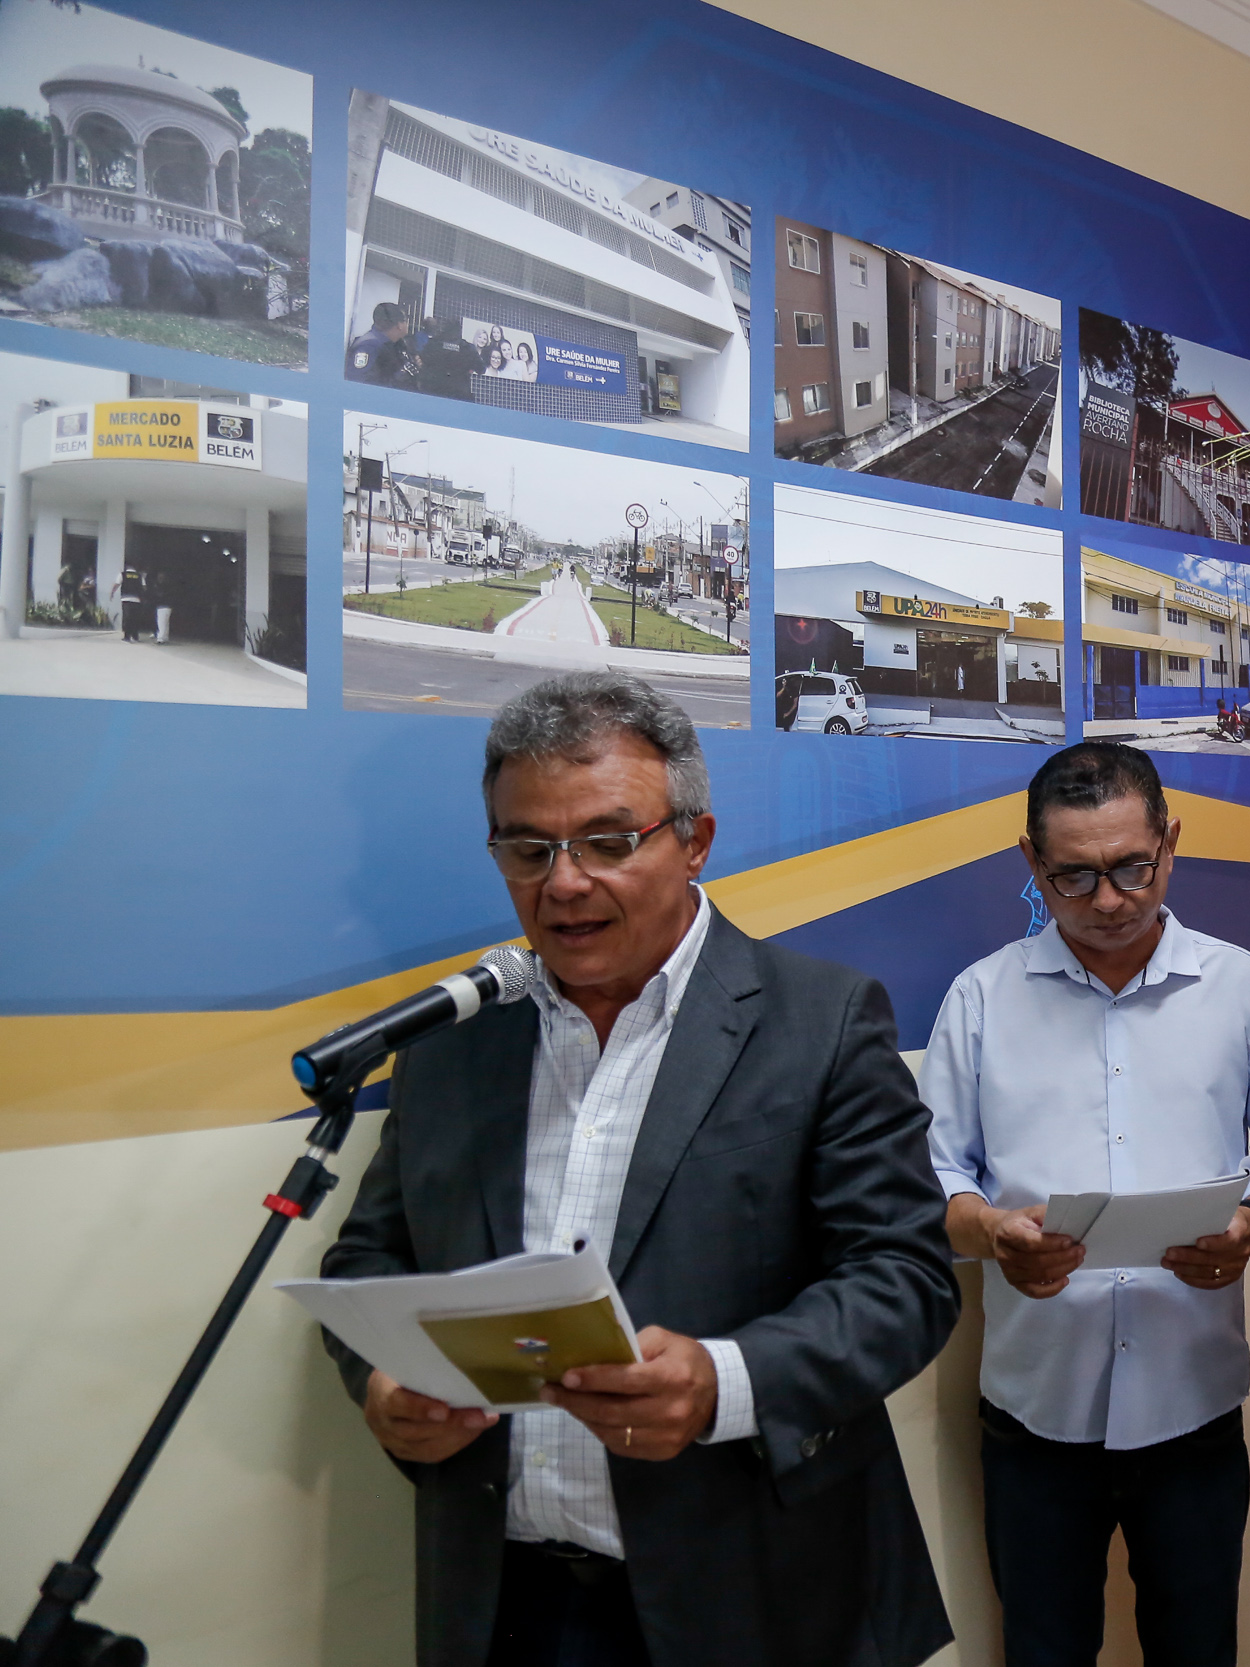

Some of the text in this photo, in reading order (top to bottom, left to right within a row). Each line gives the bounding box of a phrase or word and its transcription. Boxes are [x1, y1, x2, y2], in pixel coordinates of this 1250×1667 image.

[545, 346, 620, 369] URE SAÚDE DA MULHER
[1087, 402, 1129, 424] MUNICIPAL
[1089, 394, 1130, 416] BIBLIOTECA
[109, 412, 181, 427] MERCADO
[1085, 411, 1129, 432] AVERTANO
[1083, 418, 1127, 444] ROCHA
[97, 434, 194, 450] SANTA LUZIA
[207, 442, 254, 461] BELÉM
